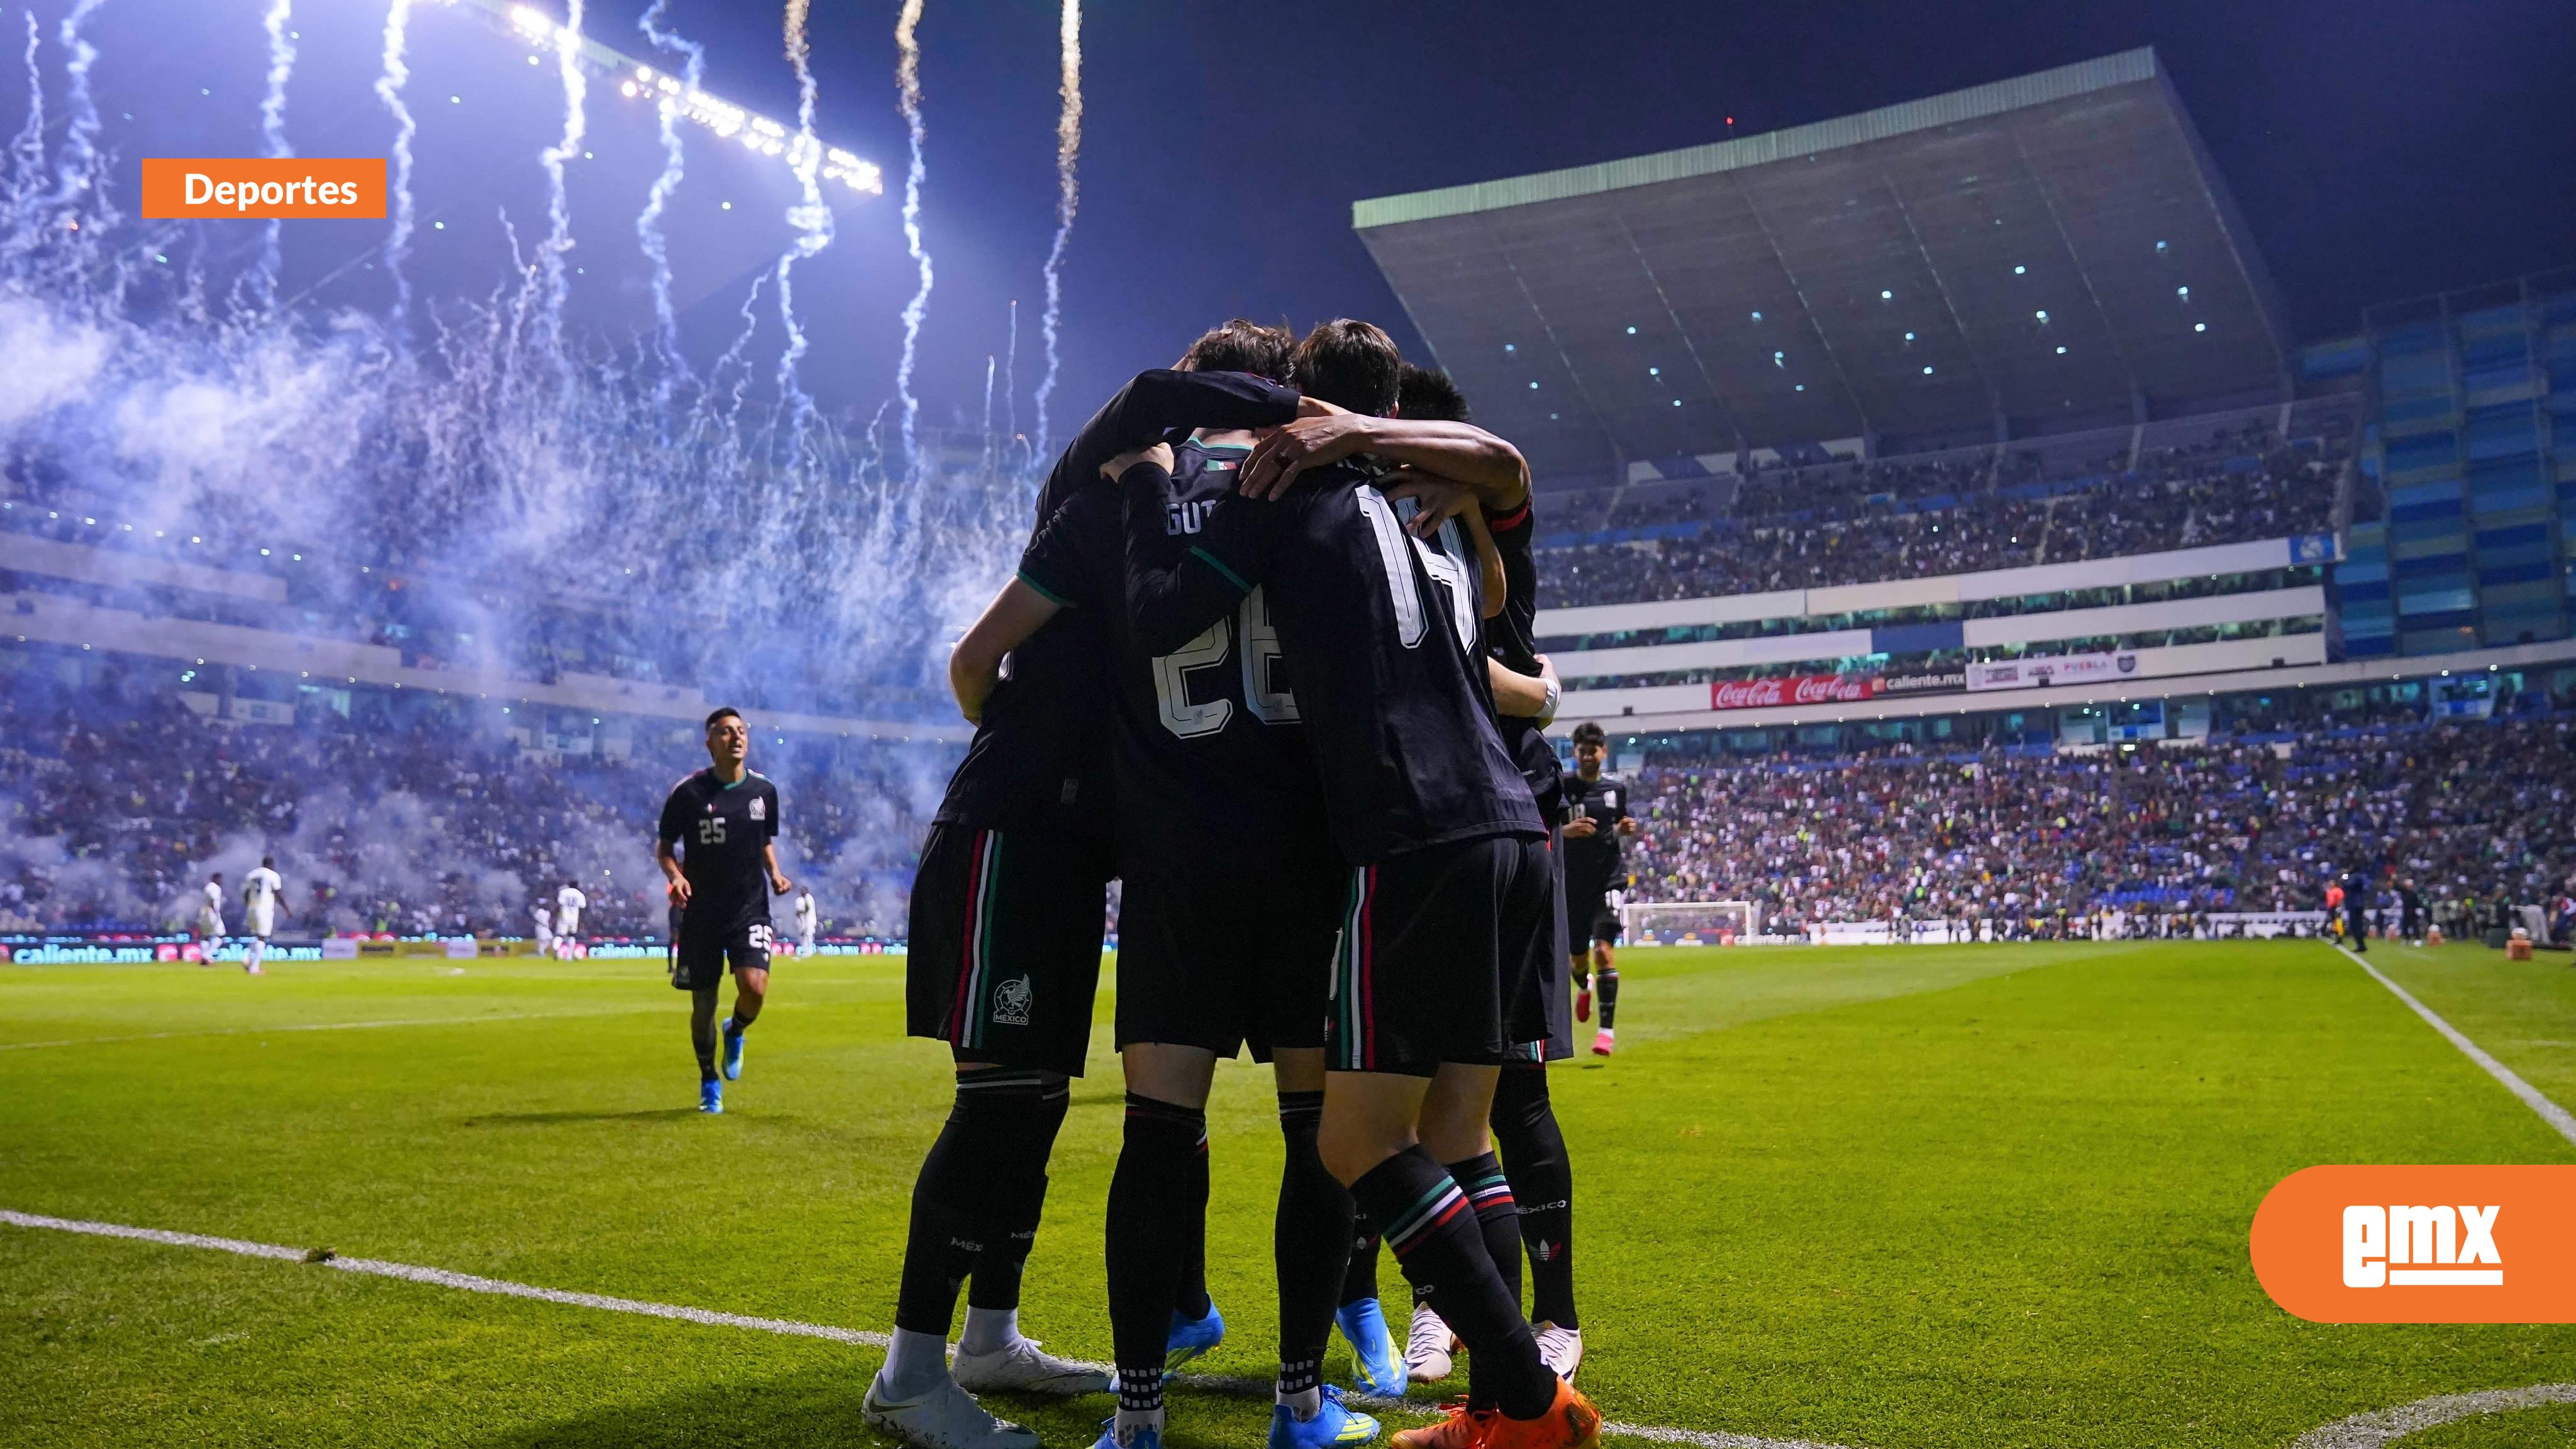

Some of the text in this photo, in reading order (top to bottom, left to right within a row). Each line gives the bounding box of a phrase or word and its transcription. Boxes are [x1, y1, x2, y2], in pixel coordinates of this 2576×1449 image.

[1355, 485, 1476, 655] 14
[1886, 673, 1965, 691] caliente.mx
[698, 817, 726, 844] 25
[748, 924, 772, 953] 25
[13, 943, 153, 964] caliente.mx
[995, 1013, 1027, 1023] MÉXICO
